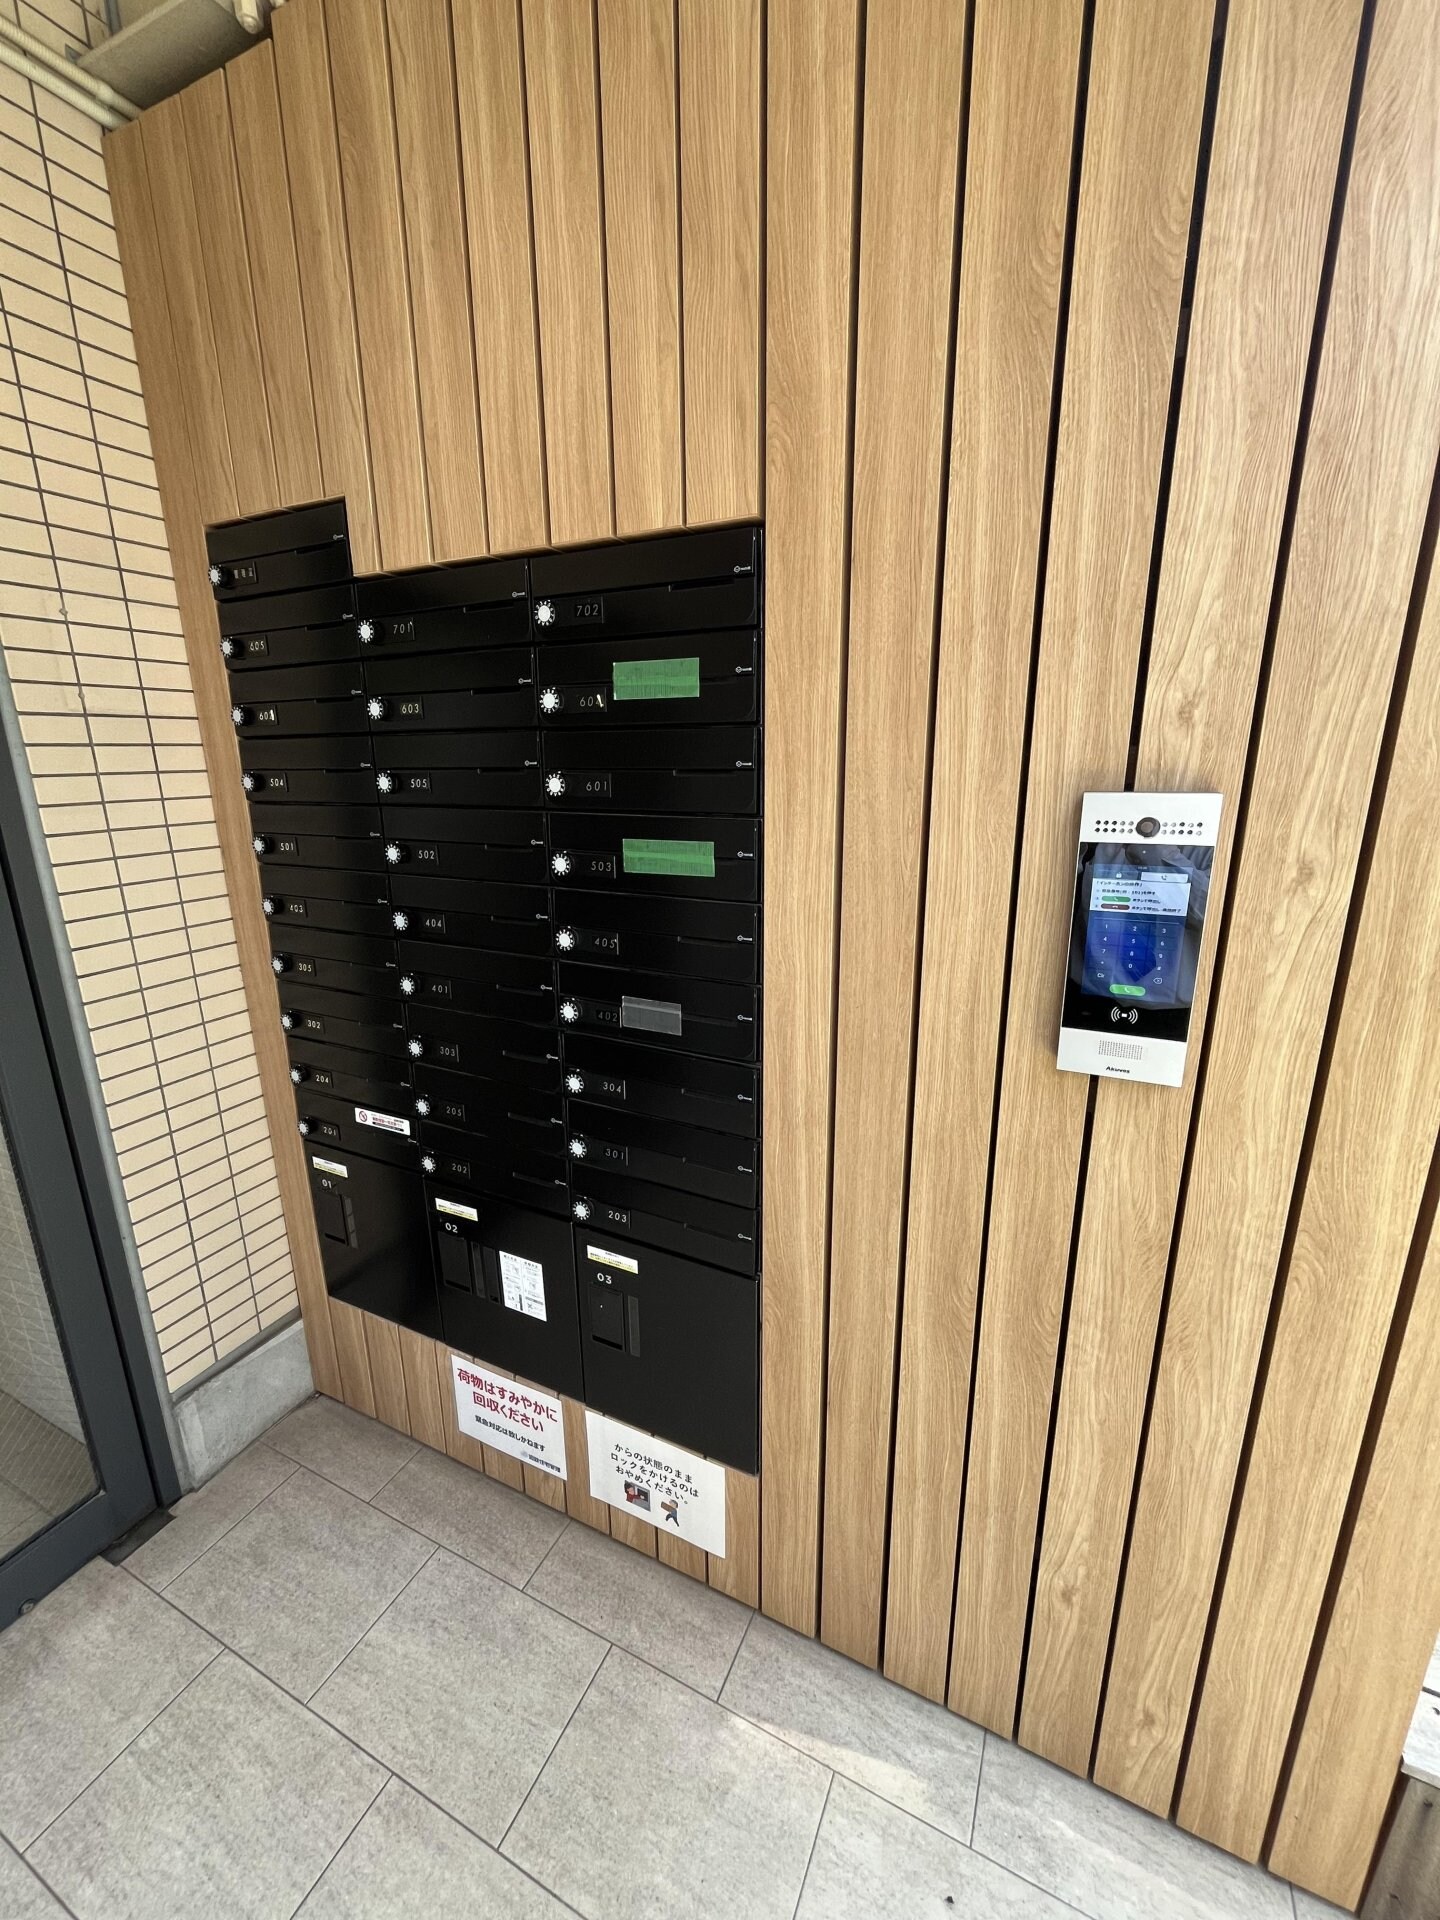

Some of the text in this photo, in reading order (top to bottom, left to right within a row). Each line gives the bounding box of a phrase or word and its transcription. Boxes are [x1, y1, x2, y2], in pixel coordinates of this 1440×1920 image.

[576, 604, 599, 616] 702
[393, 624, 411, 634] 701
[250, 640, 264, 650] 605
[402, 703, 420, 714] 603
[270, 778, 284, 786] 504
[410, 778, 428, 788] 505
[586, 781, 608, 792] 601
[280, 842, 294, 850] 501
[418, 850, 435, 860] 502
[591, 862, 612, 872] 503
[290, 904, 304, 912] 403
[425, 918, 442, 928] 404
[594, 938, 615, 948] 405
[298, 962, 312, 972] 305
[432, 984, 448, 994] 401
[598, 1012, 618, 1022] 402
[308, 1020, 320, 1028] 302
[440, 1046, 456, 1056] 303
[316, 1074, 329, 1083] 204
[603, 1082, 622, 1093] 304
[446, 1106, 462, 1116] 205
[323, 1126, 336, 1136] 201
[605, 1148, 624, 1160] 301
[452, 1164, 468, 1174] 202
[322, 1179, 332, 1188] 01
[608, 1211, 627, 1222] 203
[445, 1222, 458, 1233] 02
[597, 1273, 612, 1284] 03
[457, 1368, 558, 1422] 荷物はすみやかに
[473, 1391, 544, 1432] 回収ください
[475, 1415, 546, 1451] 緊急対応は致しかねます
[614, 1444, 692, 1484] からの状態のまま
[611, 1452, 698, 1497] ロックをかけるのは
[616, 1466, 688, 1504] おやめください。
